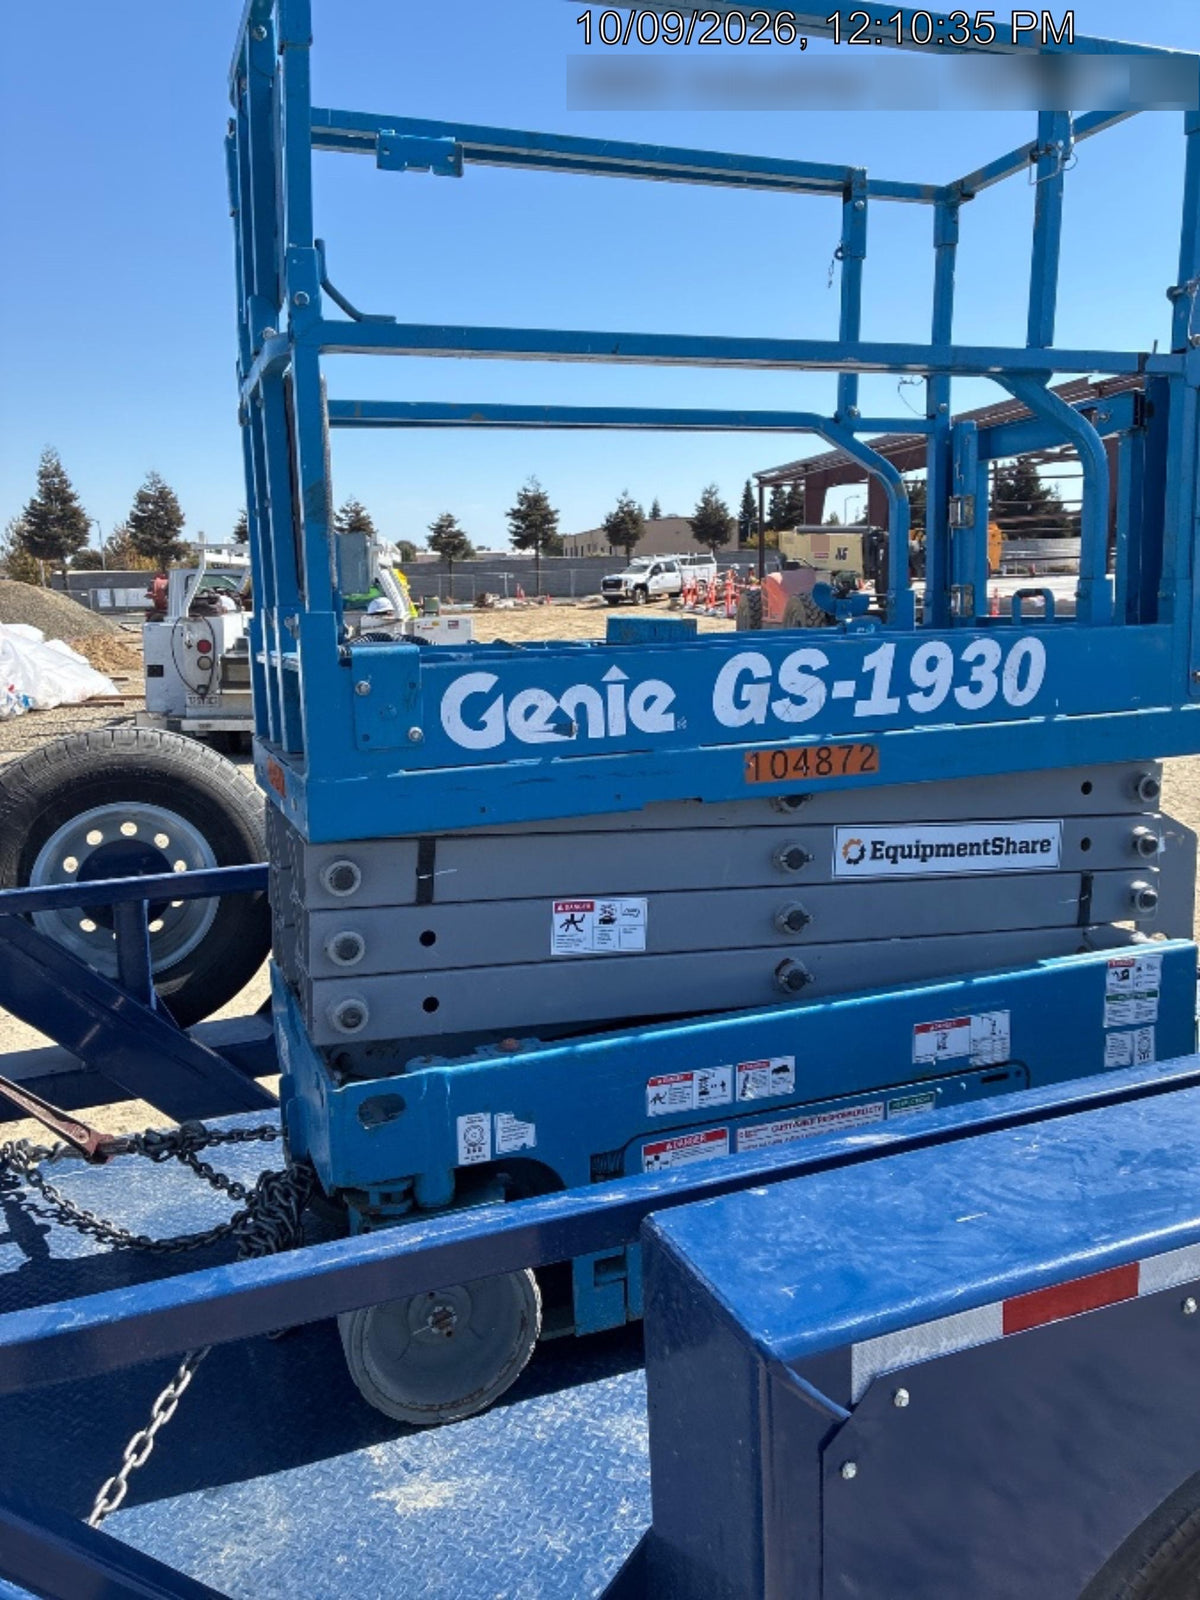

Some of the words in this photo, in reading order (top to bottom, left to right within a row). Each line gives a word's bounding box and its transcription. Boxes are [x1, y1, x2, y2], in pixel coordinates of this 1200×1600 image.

[440, 664, 676, 750] Genie
[712, 636, 1047, 728] GS-1930
[750, 743, 878, 782] 104872
[869, 836, 1052, 865] EquipmentShare
